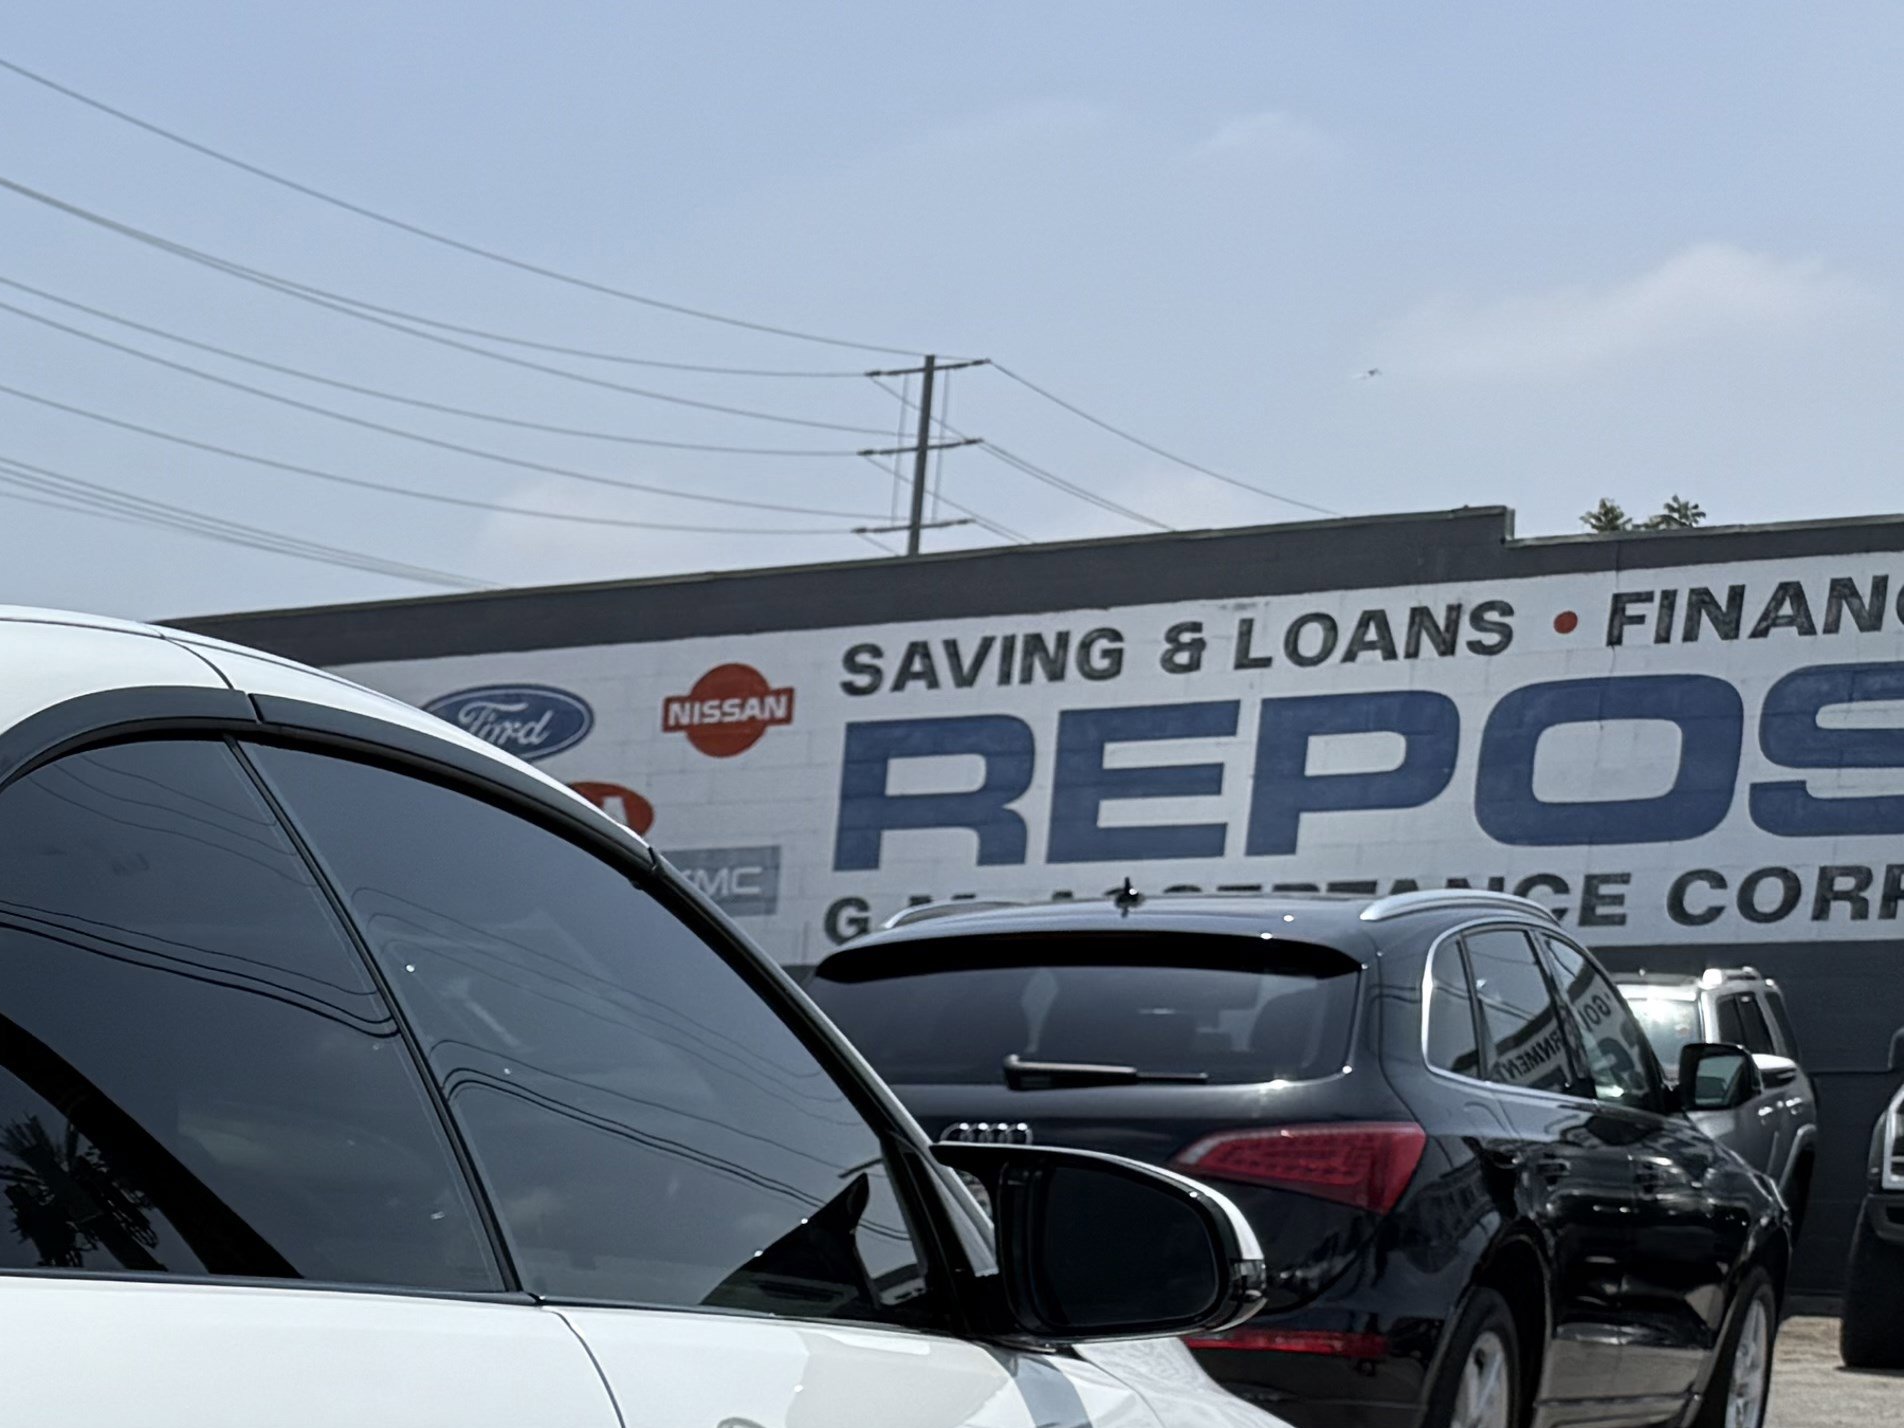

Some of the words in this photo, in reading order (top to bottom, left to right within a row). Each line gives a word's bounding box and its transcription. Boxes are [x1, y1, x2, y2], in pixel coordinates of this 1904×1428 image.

[839, 627, 1125, 696] SAVING
[1159, 620, 1206, 674] &
[1234, 599, 1515, 671] LOANS
[1606, 574, 1904, 648] FINAN
[667, 693, 789, 727] NISSAN
[681, 866, 763, 896] MC
